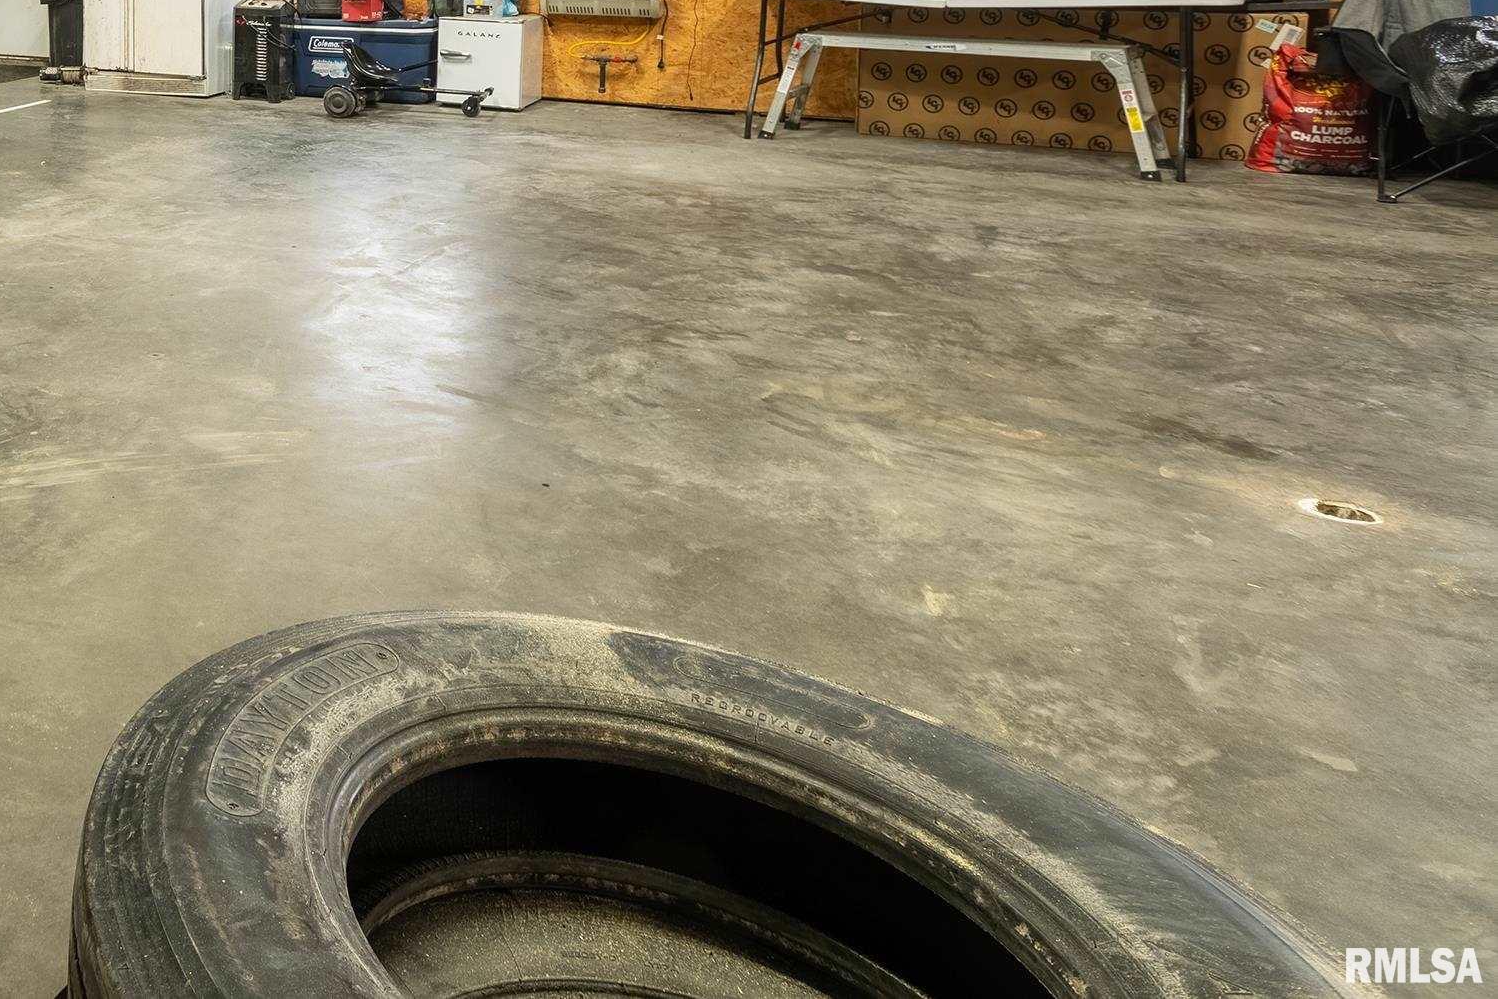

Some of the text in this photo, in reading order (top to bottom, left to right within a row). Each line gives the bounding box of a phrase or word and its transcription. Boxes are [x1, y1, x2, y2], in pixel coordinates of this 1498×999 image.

[313, 38, 342, 49] Colema
[1294, 106, 1369, 117] 100% NATURAL
[1312, 125, 1354, 136] LUMP
[1290, 130, 1369, 144] CHARCOAL
[690, 693, 835, 747] REGROOVABLE
